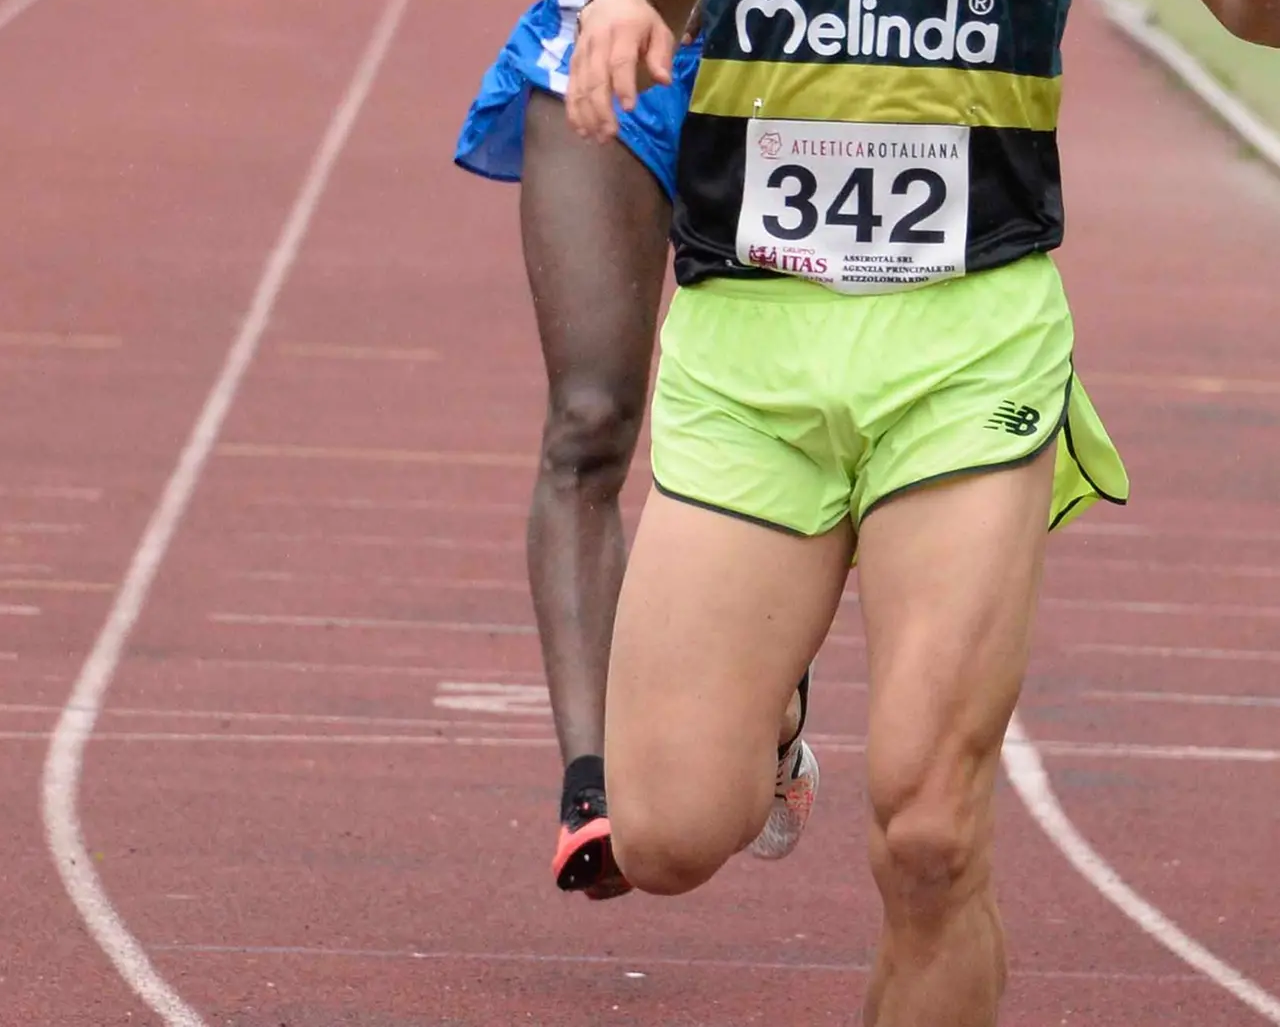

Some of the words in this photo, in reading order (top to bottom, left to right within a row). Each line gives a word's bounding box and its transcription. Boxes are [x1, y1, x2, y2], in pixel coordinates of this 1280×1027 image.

[791, 139, 959, 159] ATLETICAROTALIANA
[762, 164, 947, 244] 342
[782, 255, 828, 274] ITAS
[843, 255, 895, 263] ASSIROTAL
[843, 264, 883, 273] AGENZIA
